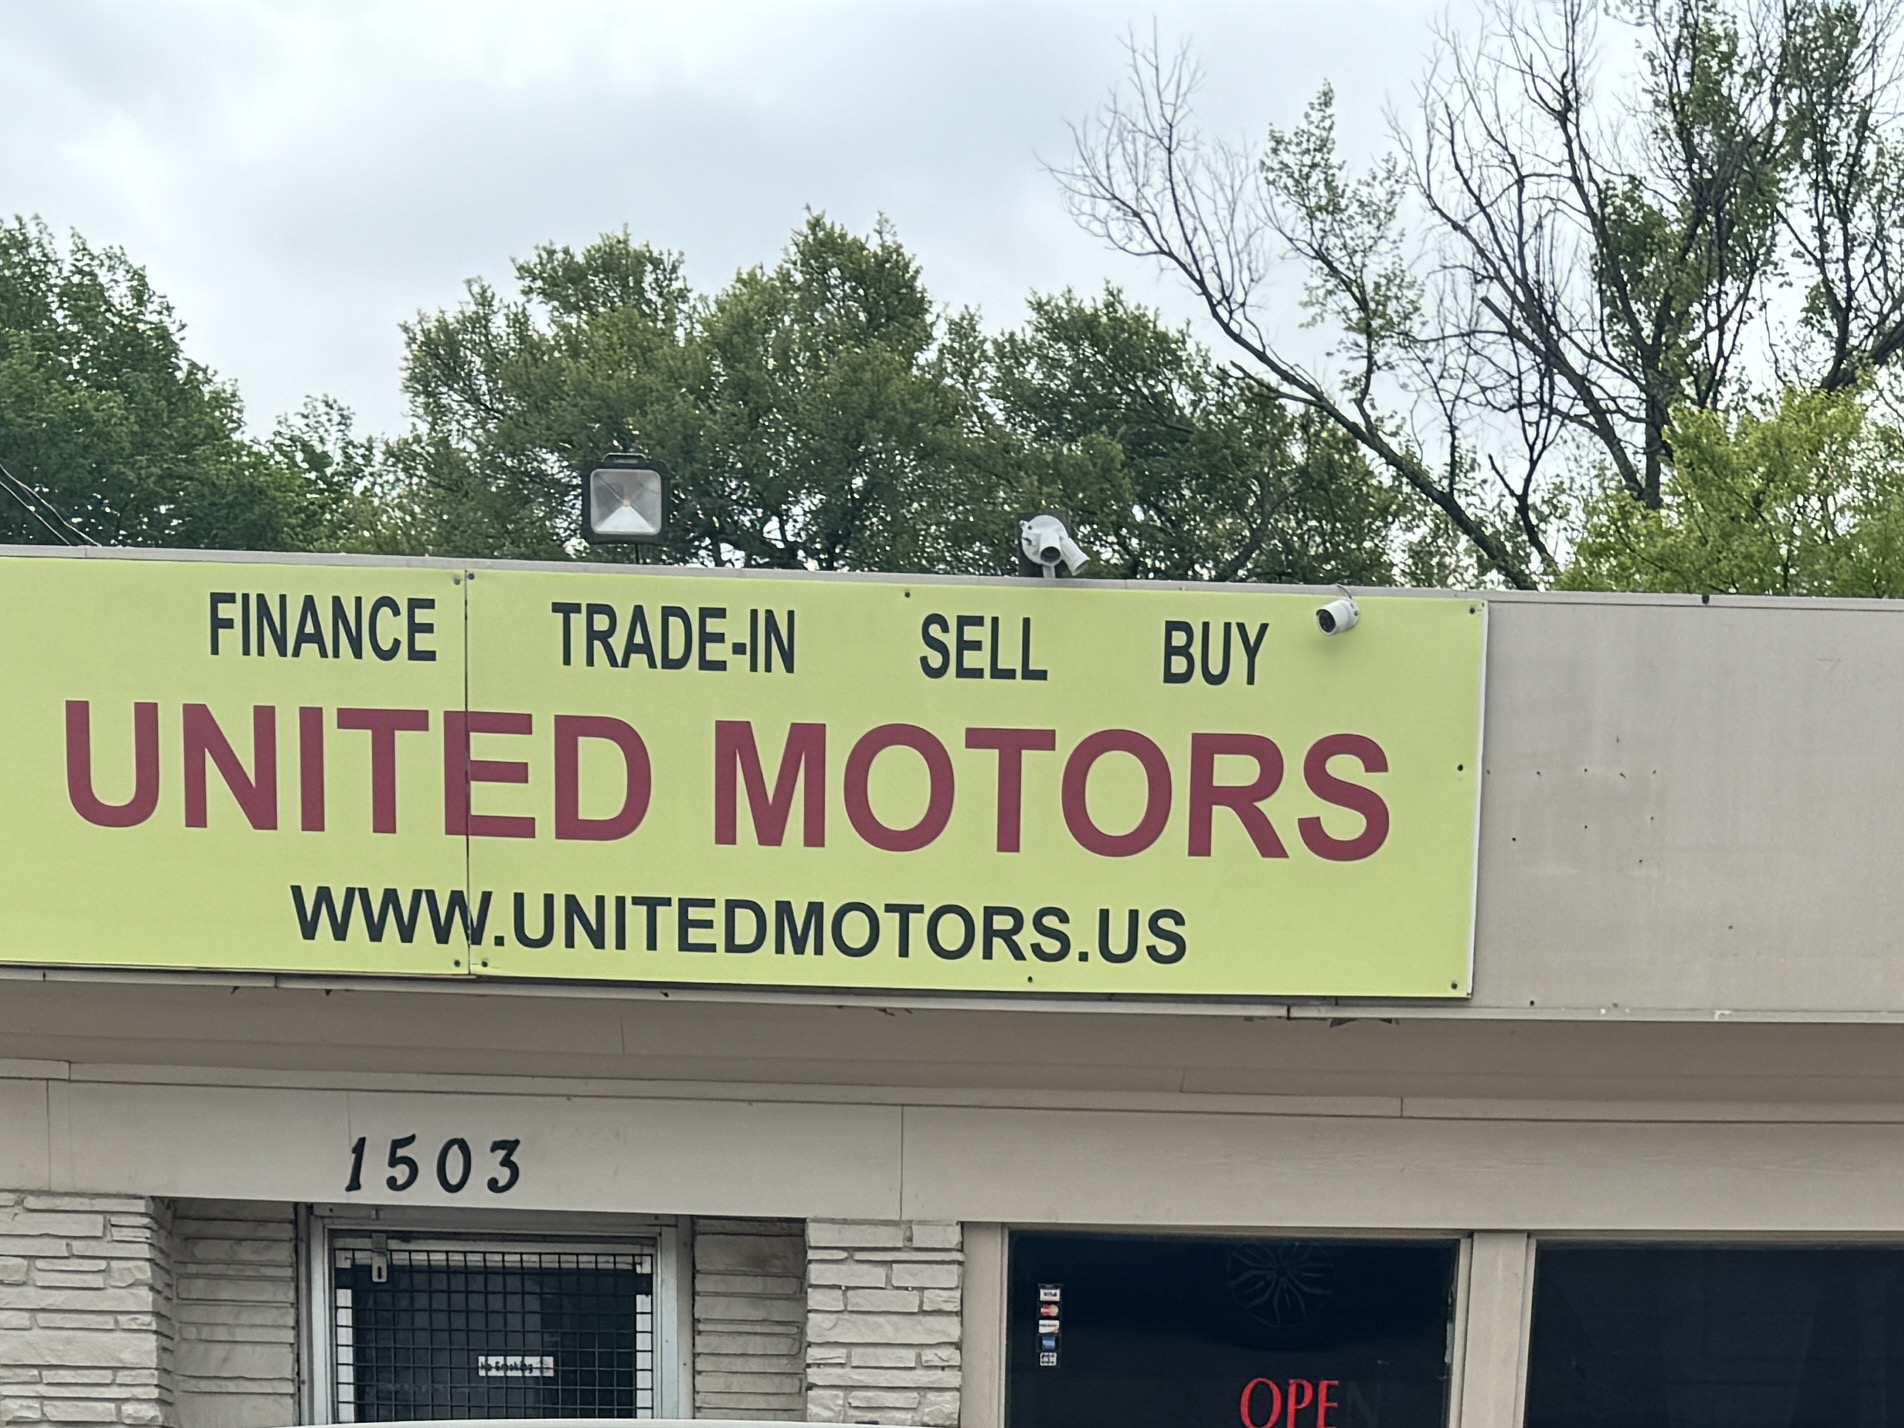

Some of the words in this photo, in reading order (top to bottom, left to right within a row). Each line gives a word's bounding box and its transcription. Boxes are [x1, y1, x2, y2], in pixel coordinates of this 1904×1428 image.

[208, 591, 438, 662] FINANCE
[551, 601, 796, 674] TRADE-IN
[919, 612, 1048, 681] SELL
[1162, 620, 1270, 687] BUY
[65, 700, 653, 842] UNITED
[713, 719, 1390, 862] MOTORS
[290, 884, 1188, 966] WWW.UNITEDMOTORS.US
[345, 1133, 522, 1194] 1503
